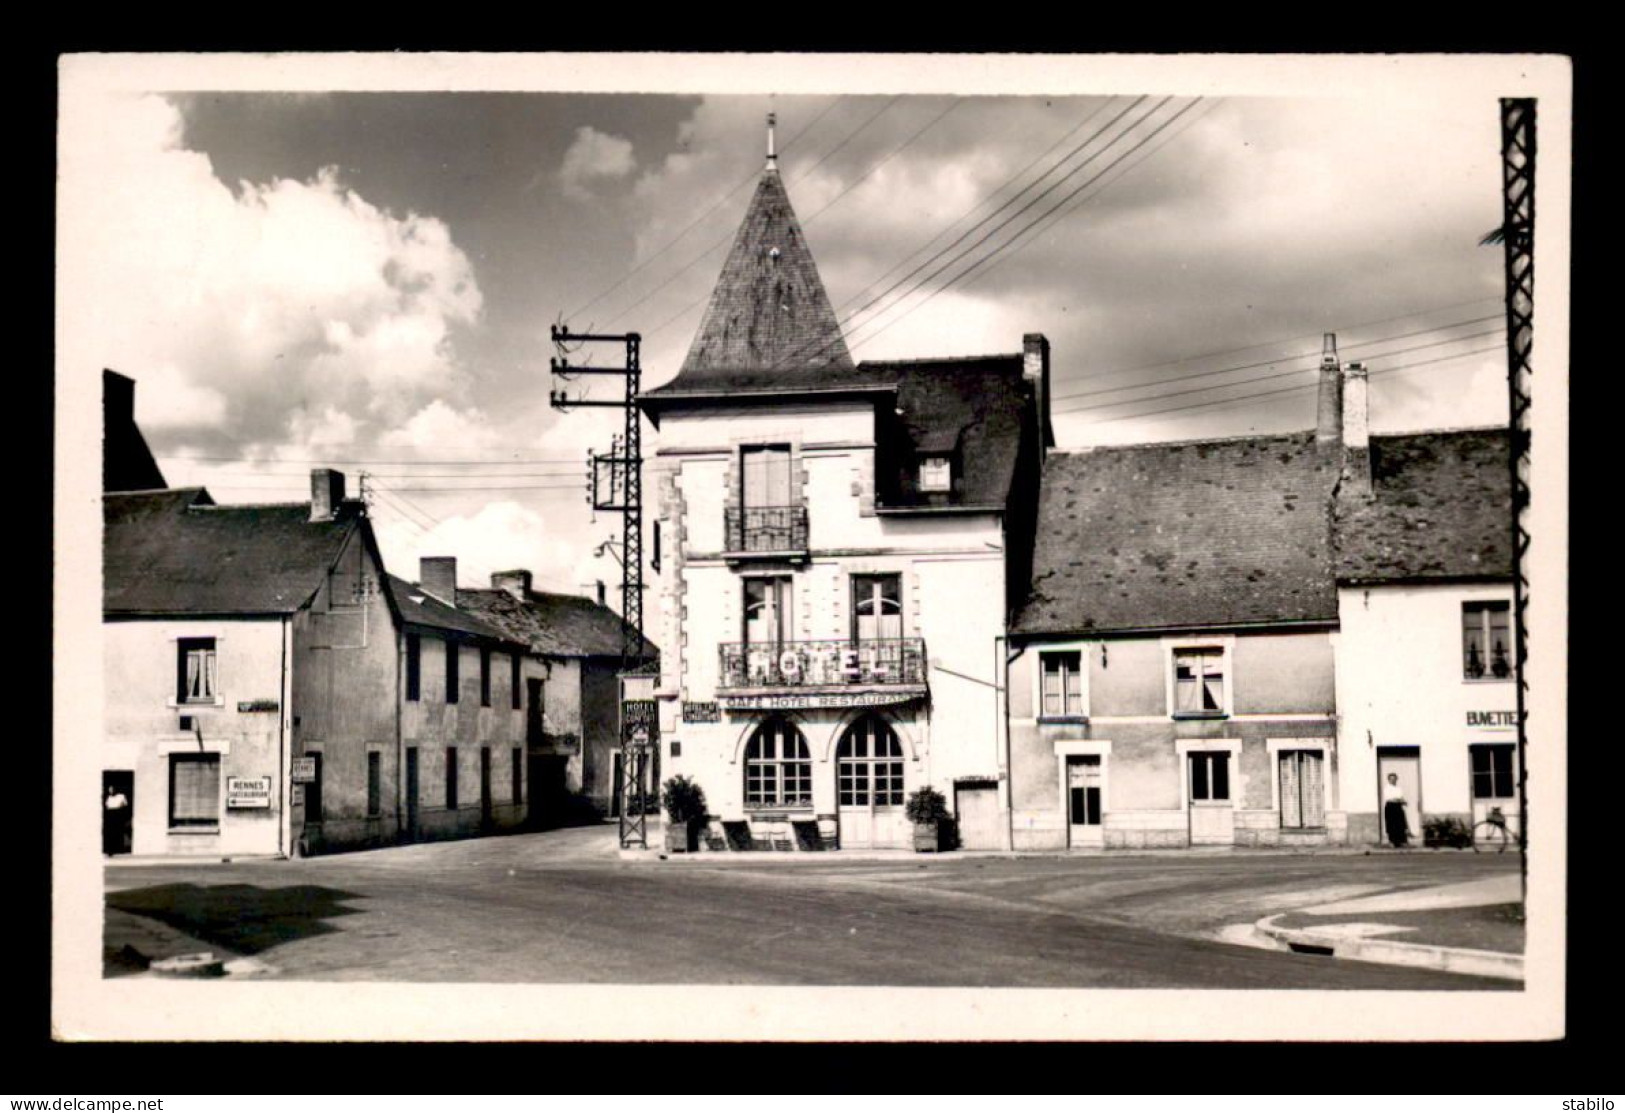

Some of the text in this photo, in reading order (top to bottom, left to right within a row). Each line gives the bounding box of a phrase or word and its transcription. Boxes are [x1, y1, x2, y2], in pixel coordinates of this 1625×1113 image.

[748, 648, 889, 679] HOTEL
[770, 695, 810, 708] HOTEL
[1466, 711, 1517, 726] BUVETTE
[233, 781, 264, 790] RENNES
